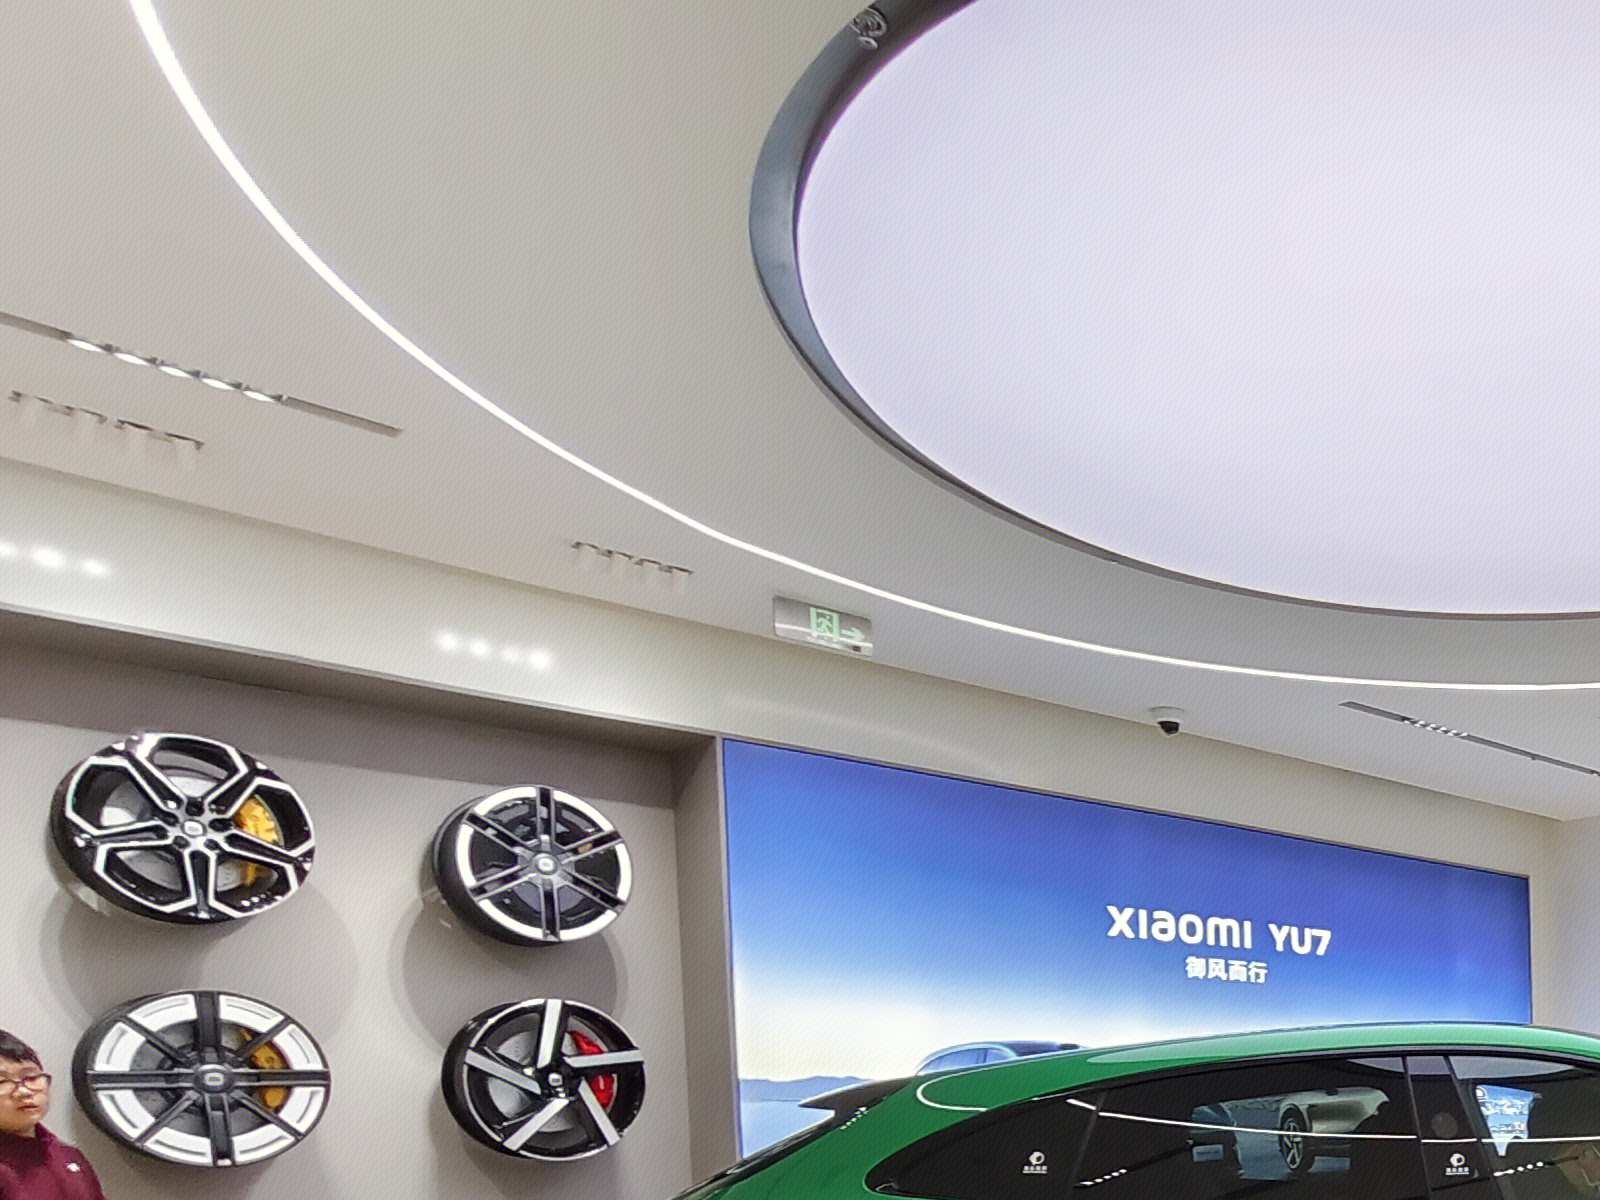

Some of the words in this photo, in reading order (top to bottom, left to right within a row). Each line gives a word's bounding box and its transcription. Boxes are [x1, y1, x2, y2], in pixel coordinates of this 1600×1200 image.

[1268, 923, 1332, 956] YU7
[1185, 956, 1268, 984] 御风而行
